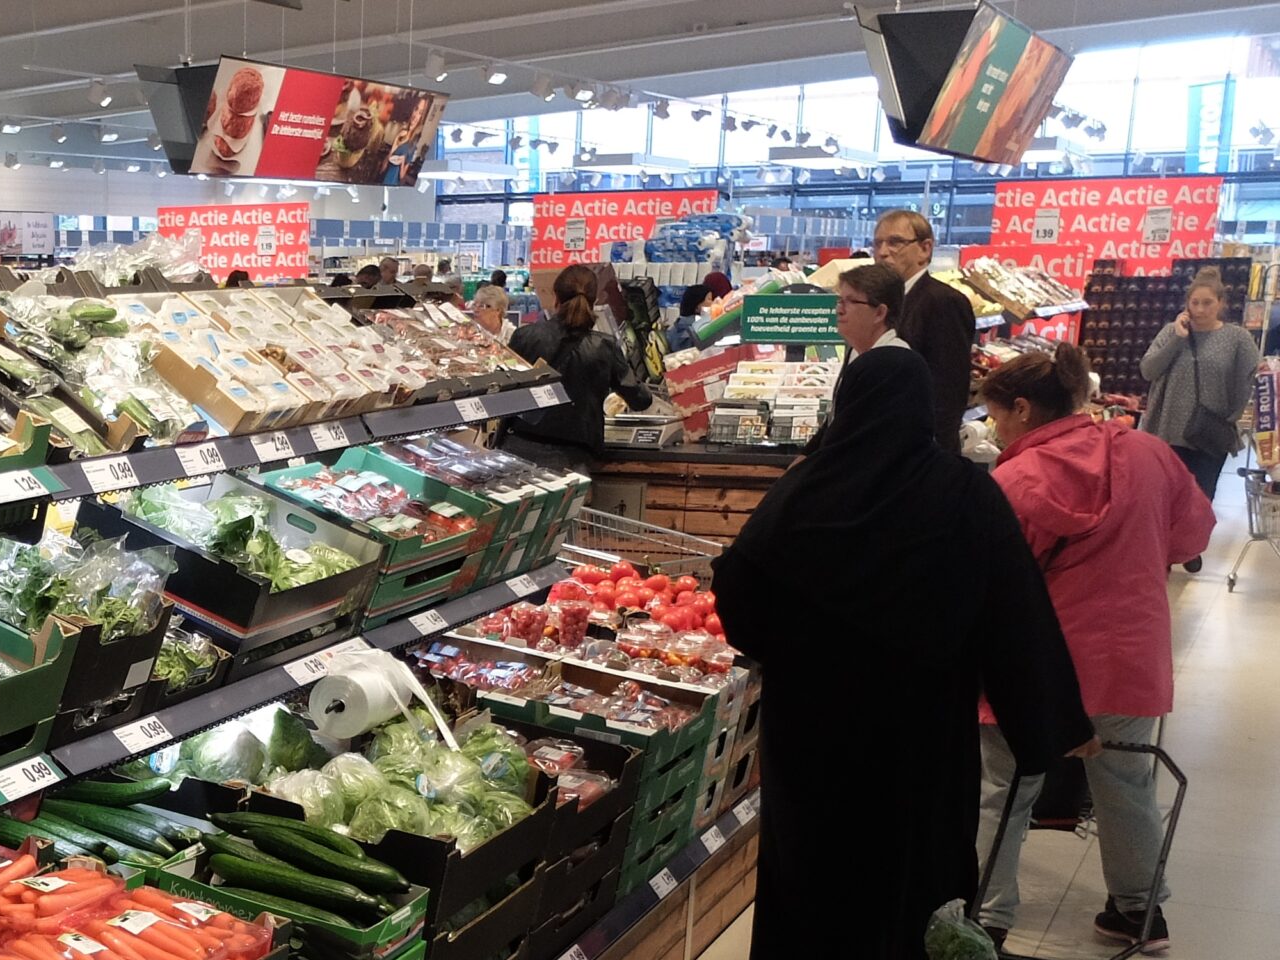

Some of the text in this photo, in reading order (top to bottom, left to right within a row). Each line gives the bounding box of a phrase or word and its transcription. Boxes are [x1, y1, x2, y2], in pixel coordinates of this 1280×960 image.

[1040, 187, 1100, 207] Actie
[1105, 185, 1168, 206] Actie
[570, 199, 618, 217] Actie
[623, 198, 673, 216] Actie
[188, 210, 228, 227] Actie
[232, 208, 272, 226] Actie
[1070, 213, 1130, 233] Actie
[210, 231, 249, 247] Actie
[595, 223, 644, 240] Actie
[1100, 240, 1160, 259] Actie
[232, 252, 272, 268] Actie
[1259, 375, 1271, 413] ROLLS
[200, 447, 221, 466] 0.99
[109, 462, 135, 482] 0.99
[140, 720, 166, 739] 0.99
[22, 761, 53, 783] 0.99
